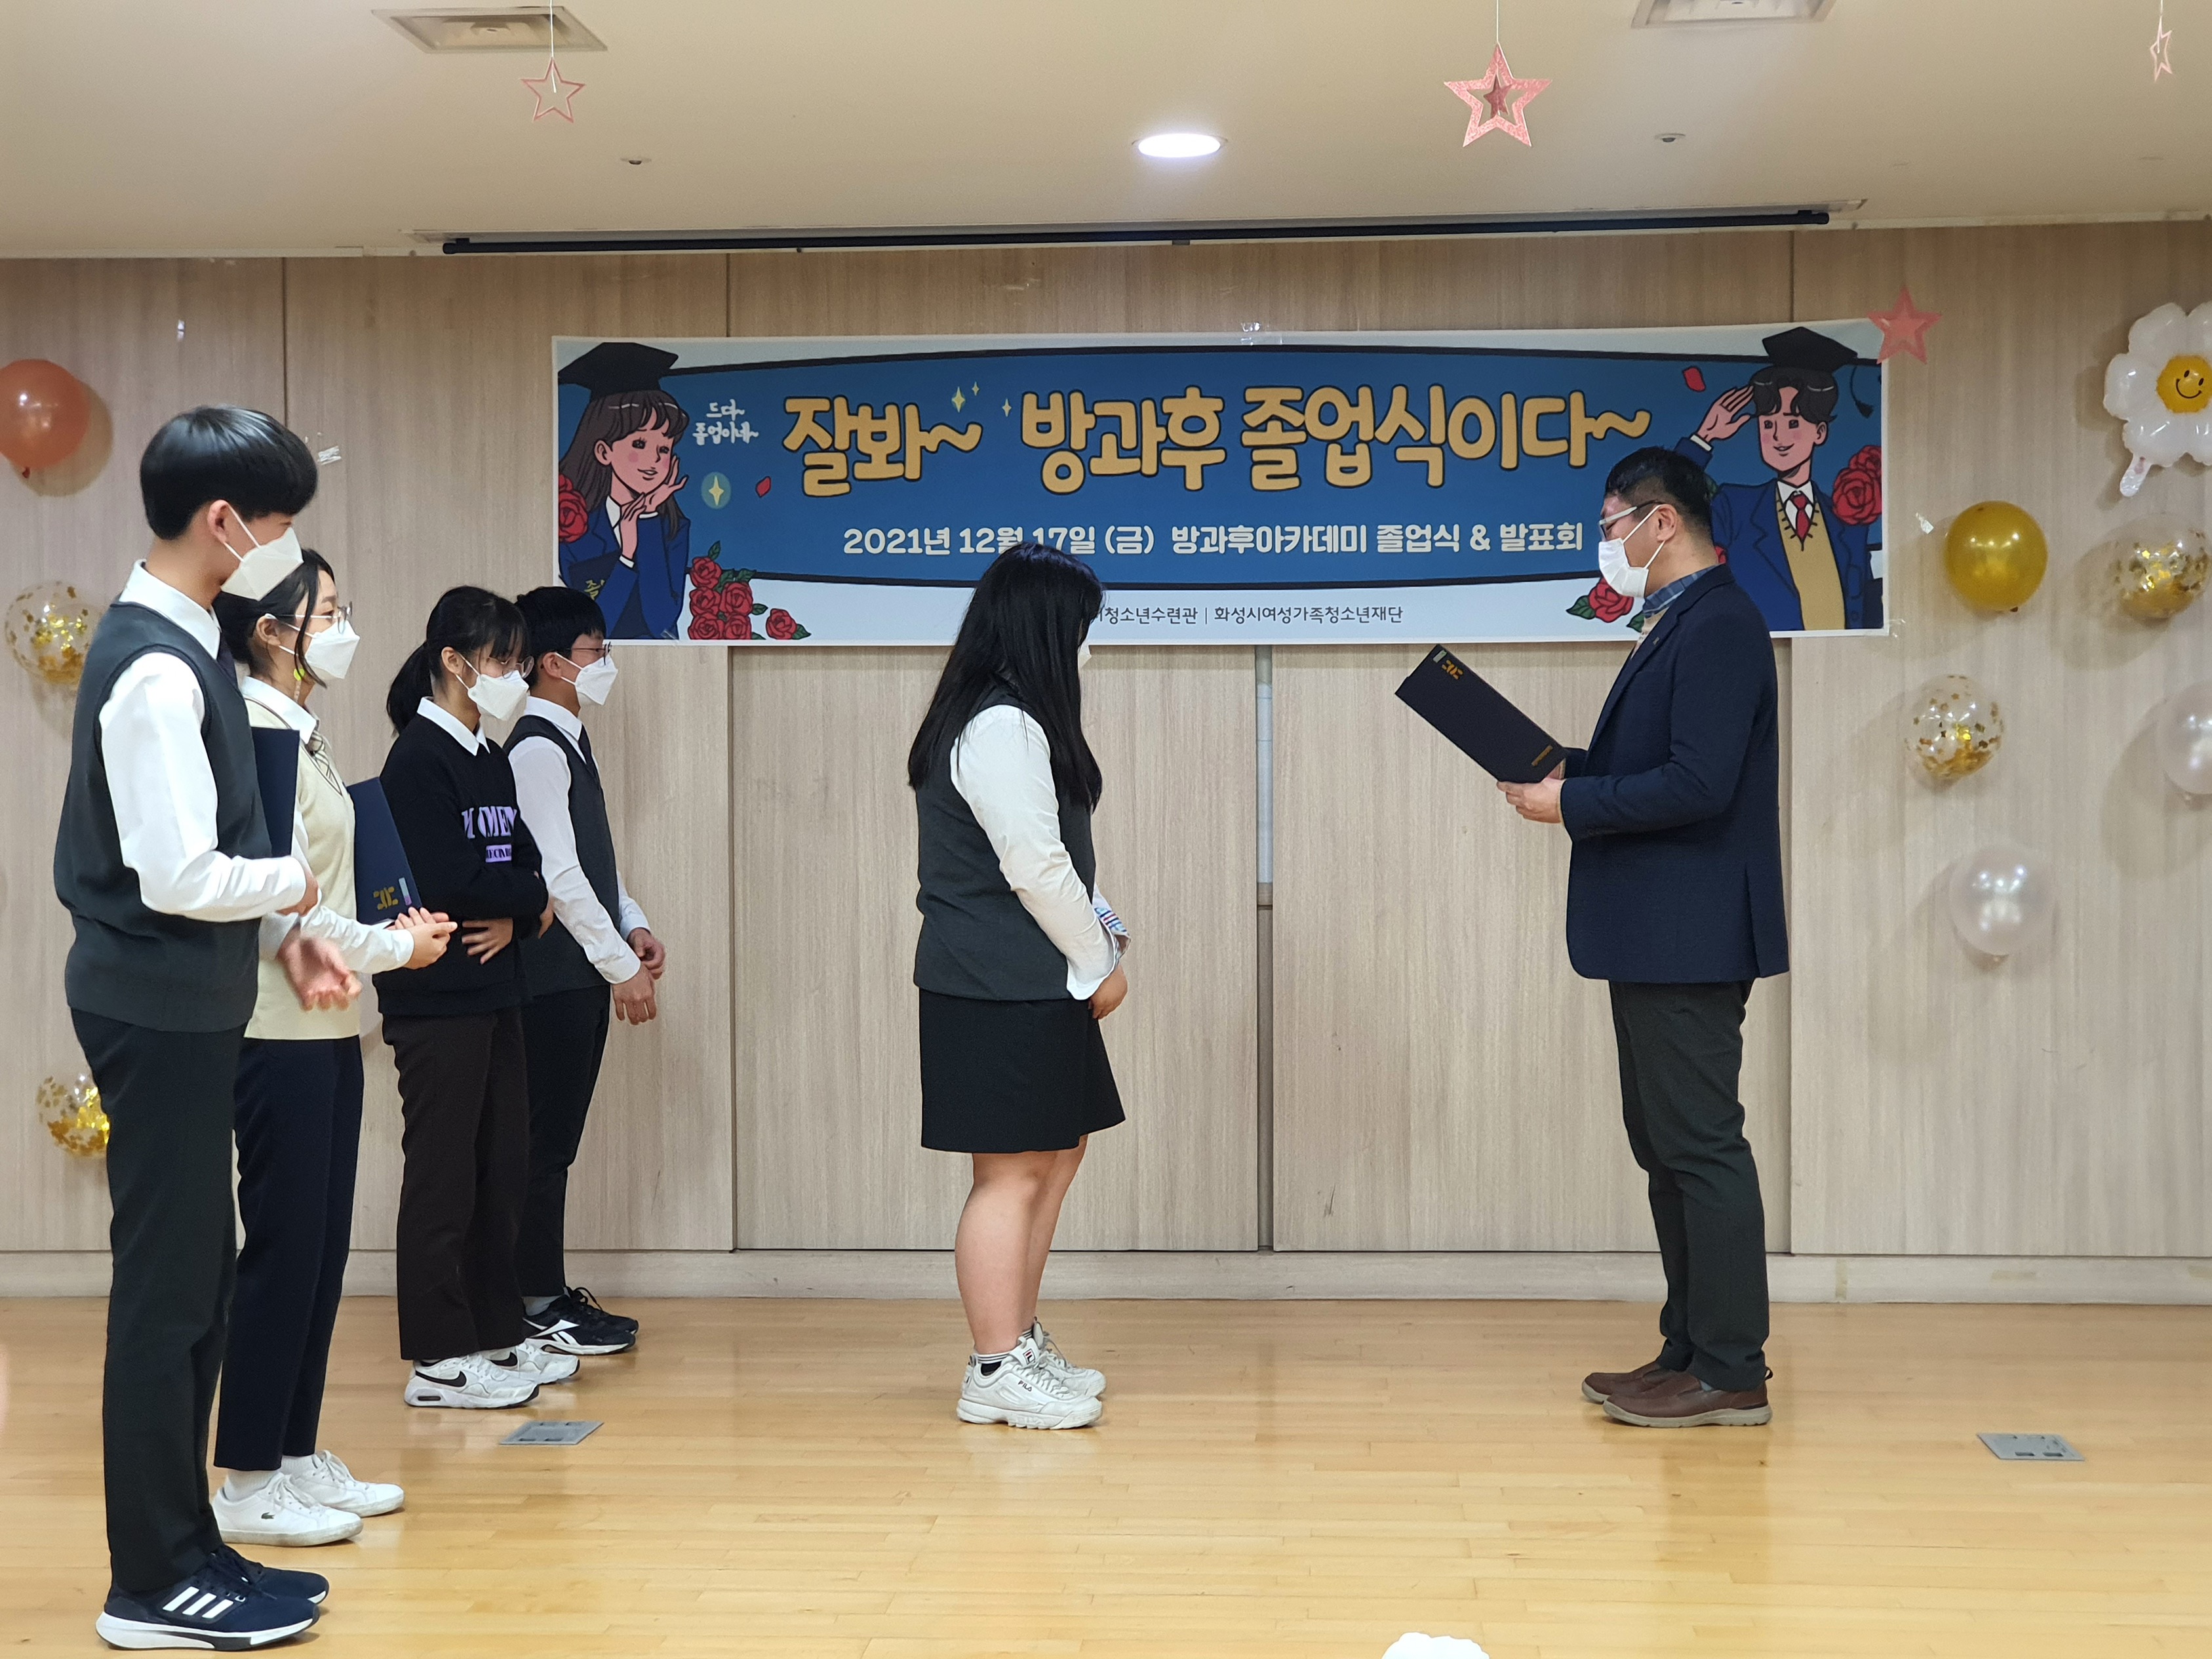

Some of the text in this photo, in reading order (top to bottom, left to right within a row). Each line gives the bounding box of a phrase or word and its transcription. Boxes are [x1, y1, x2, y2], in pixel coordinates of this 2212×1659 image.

[1021, 386, 1227, 494] 방과후
[844, 522, 1583, 555] 2021년 12월 17일 (금) 방과후아카데미 졸업식 & 발표회
[1214, 606, 1403, 624] 화성시여성가족청소년재단
[1018, 1380, 1033, 1392] FILA
